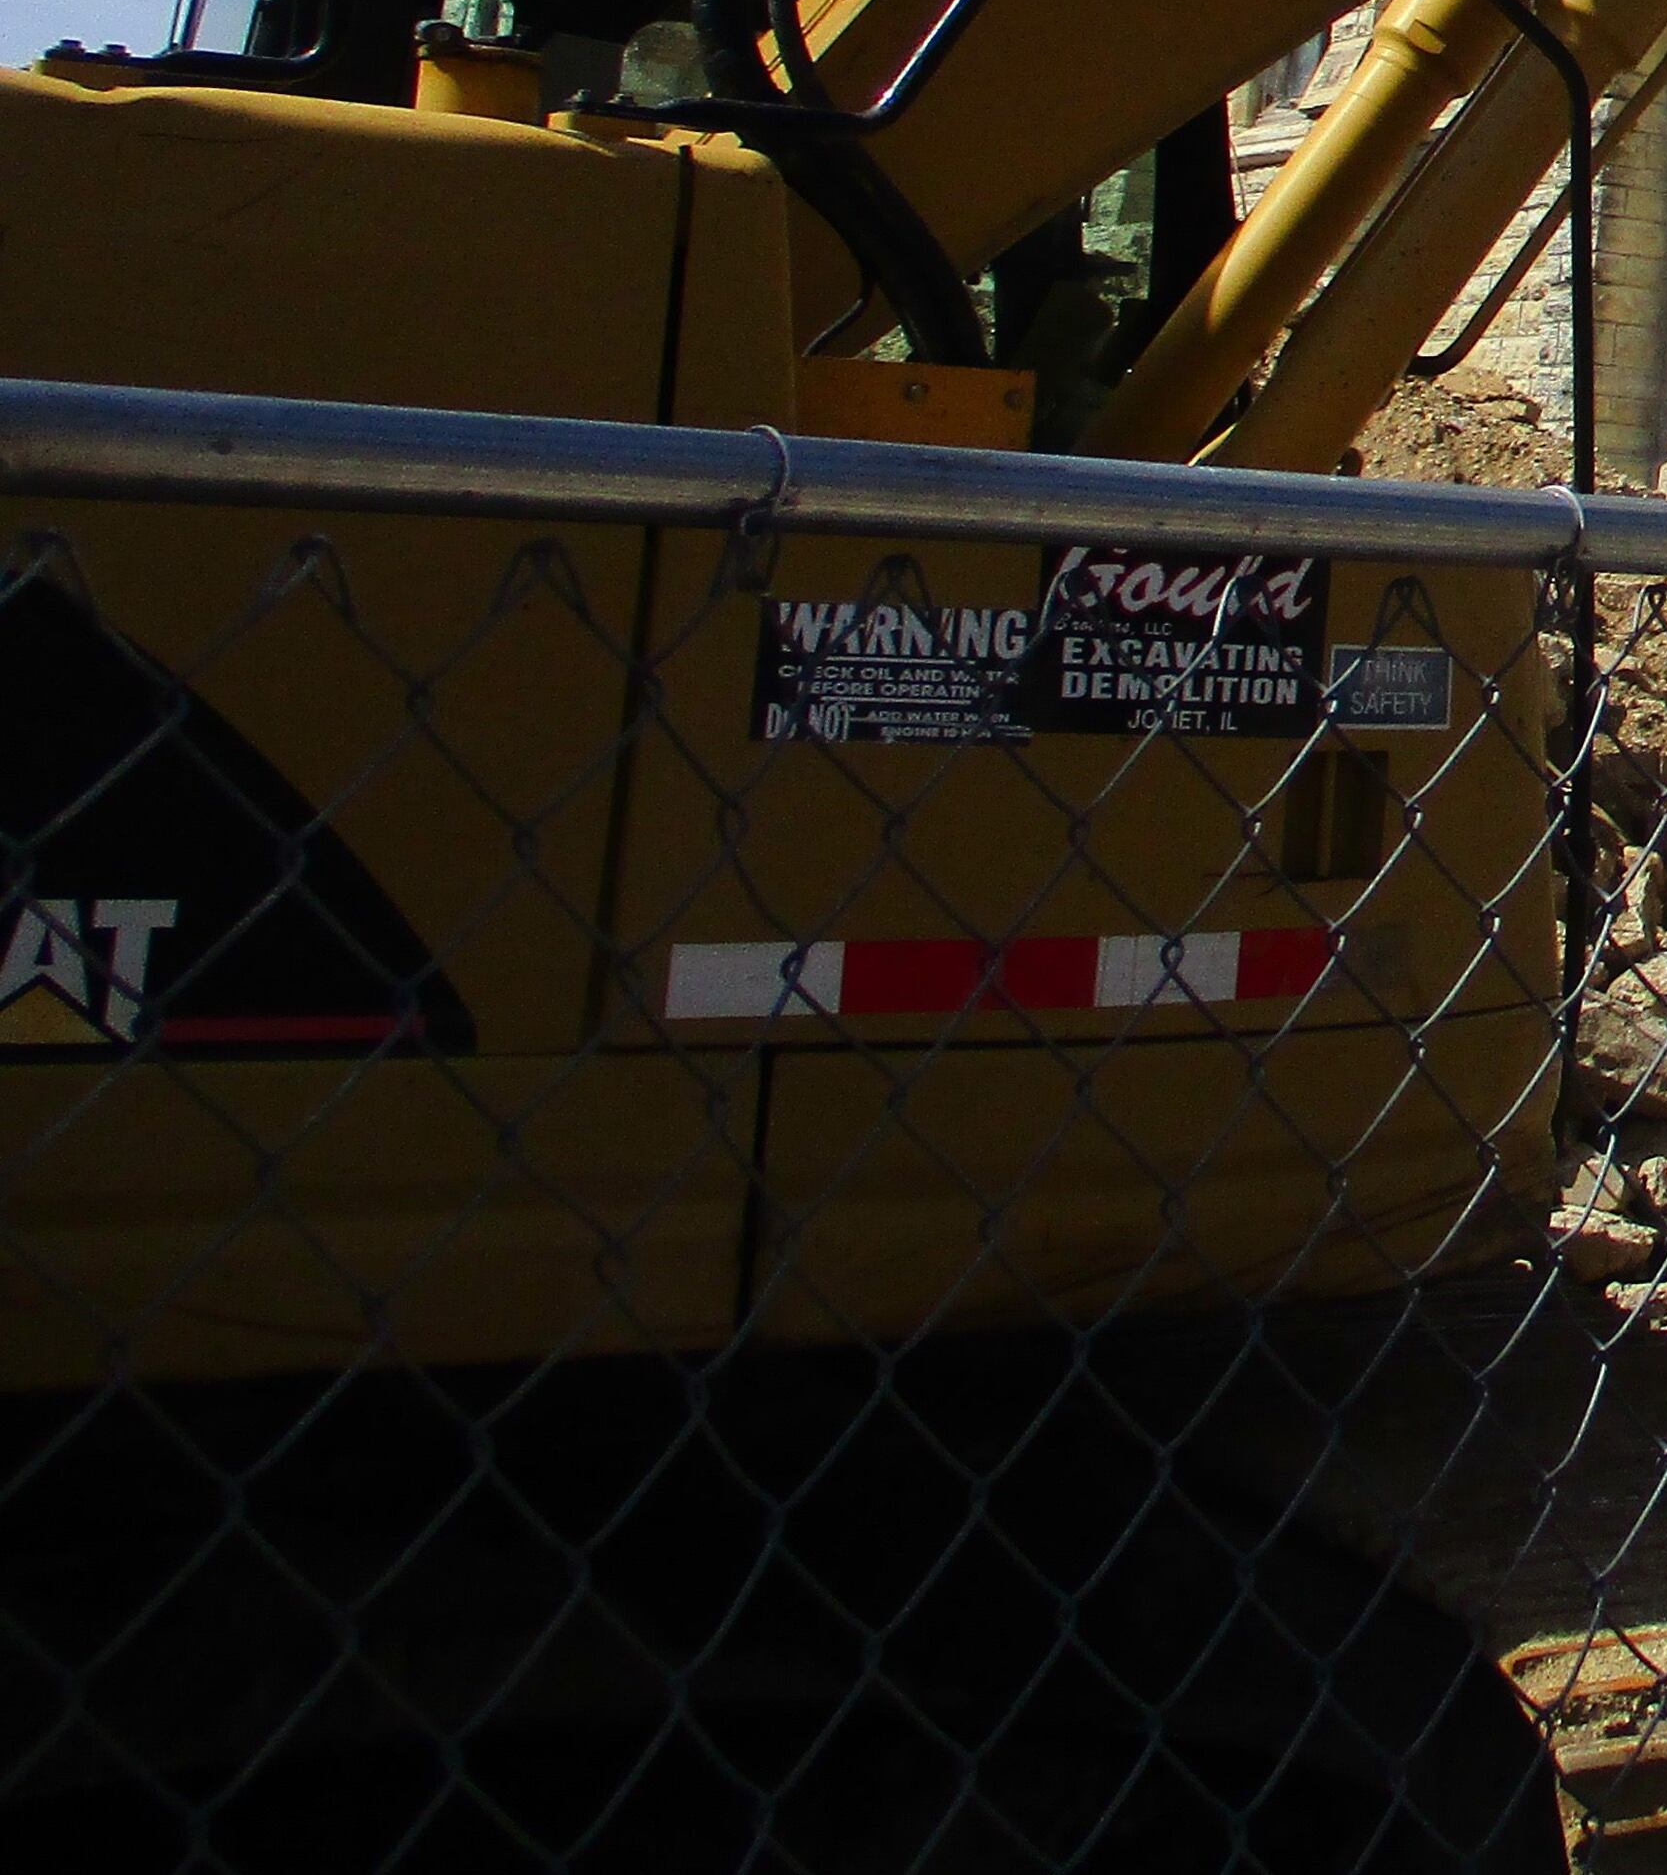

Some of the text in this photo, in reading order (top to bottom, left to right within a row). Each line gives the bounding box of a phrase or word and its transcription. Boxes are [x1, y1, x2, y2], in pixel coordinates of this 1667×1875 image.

[1144, 621, 1173, 636] LLC
[1062, 636, 1304, 674] EXCAVATING
[860, 666, 895, 681] OIL
[900, 668, 945, 682] AND
[1061, 670, 1299, 705] DEMOLITION
[1350, 690, 1433, 716] SAFETY
[808, 701, 856, 743] NOT
[907, 711, 960, 723] WATER
[1220, 711, 1239, 731] IL
